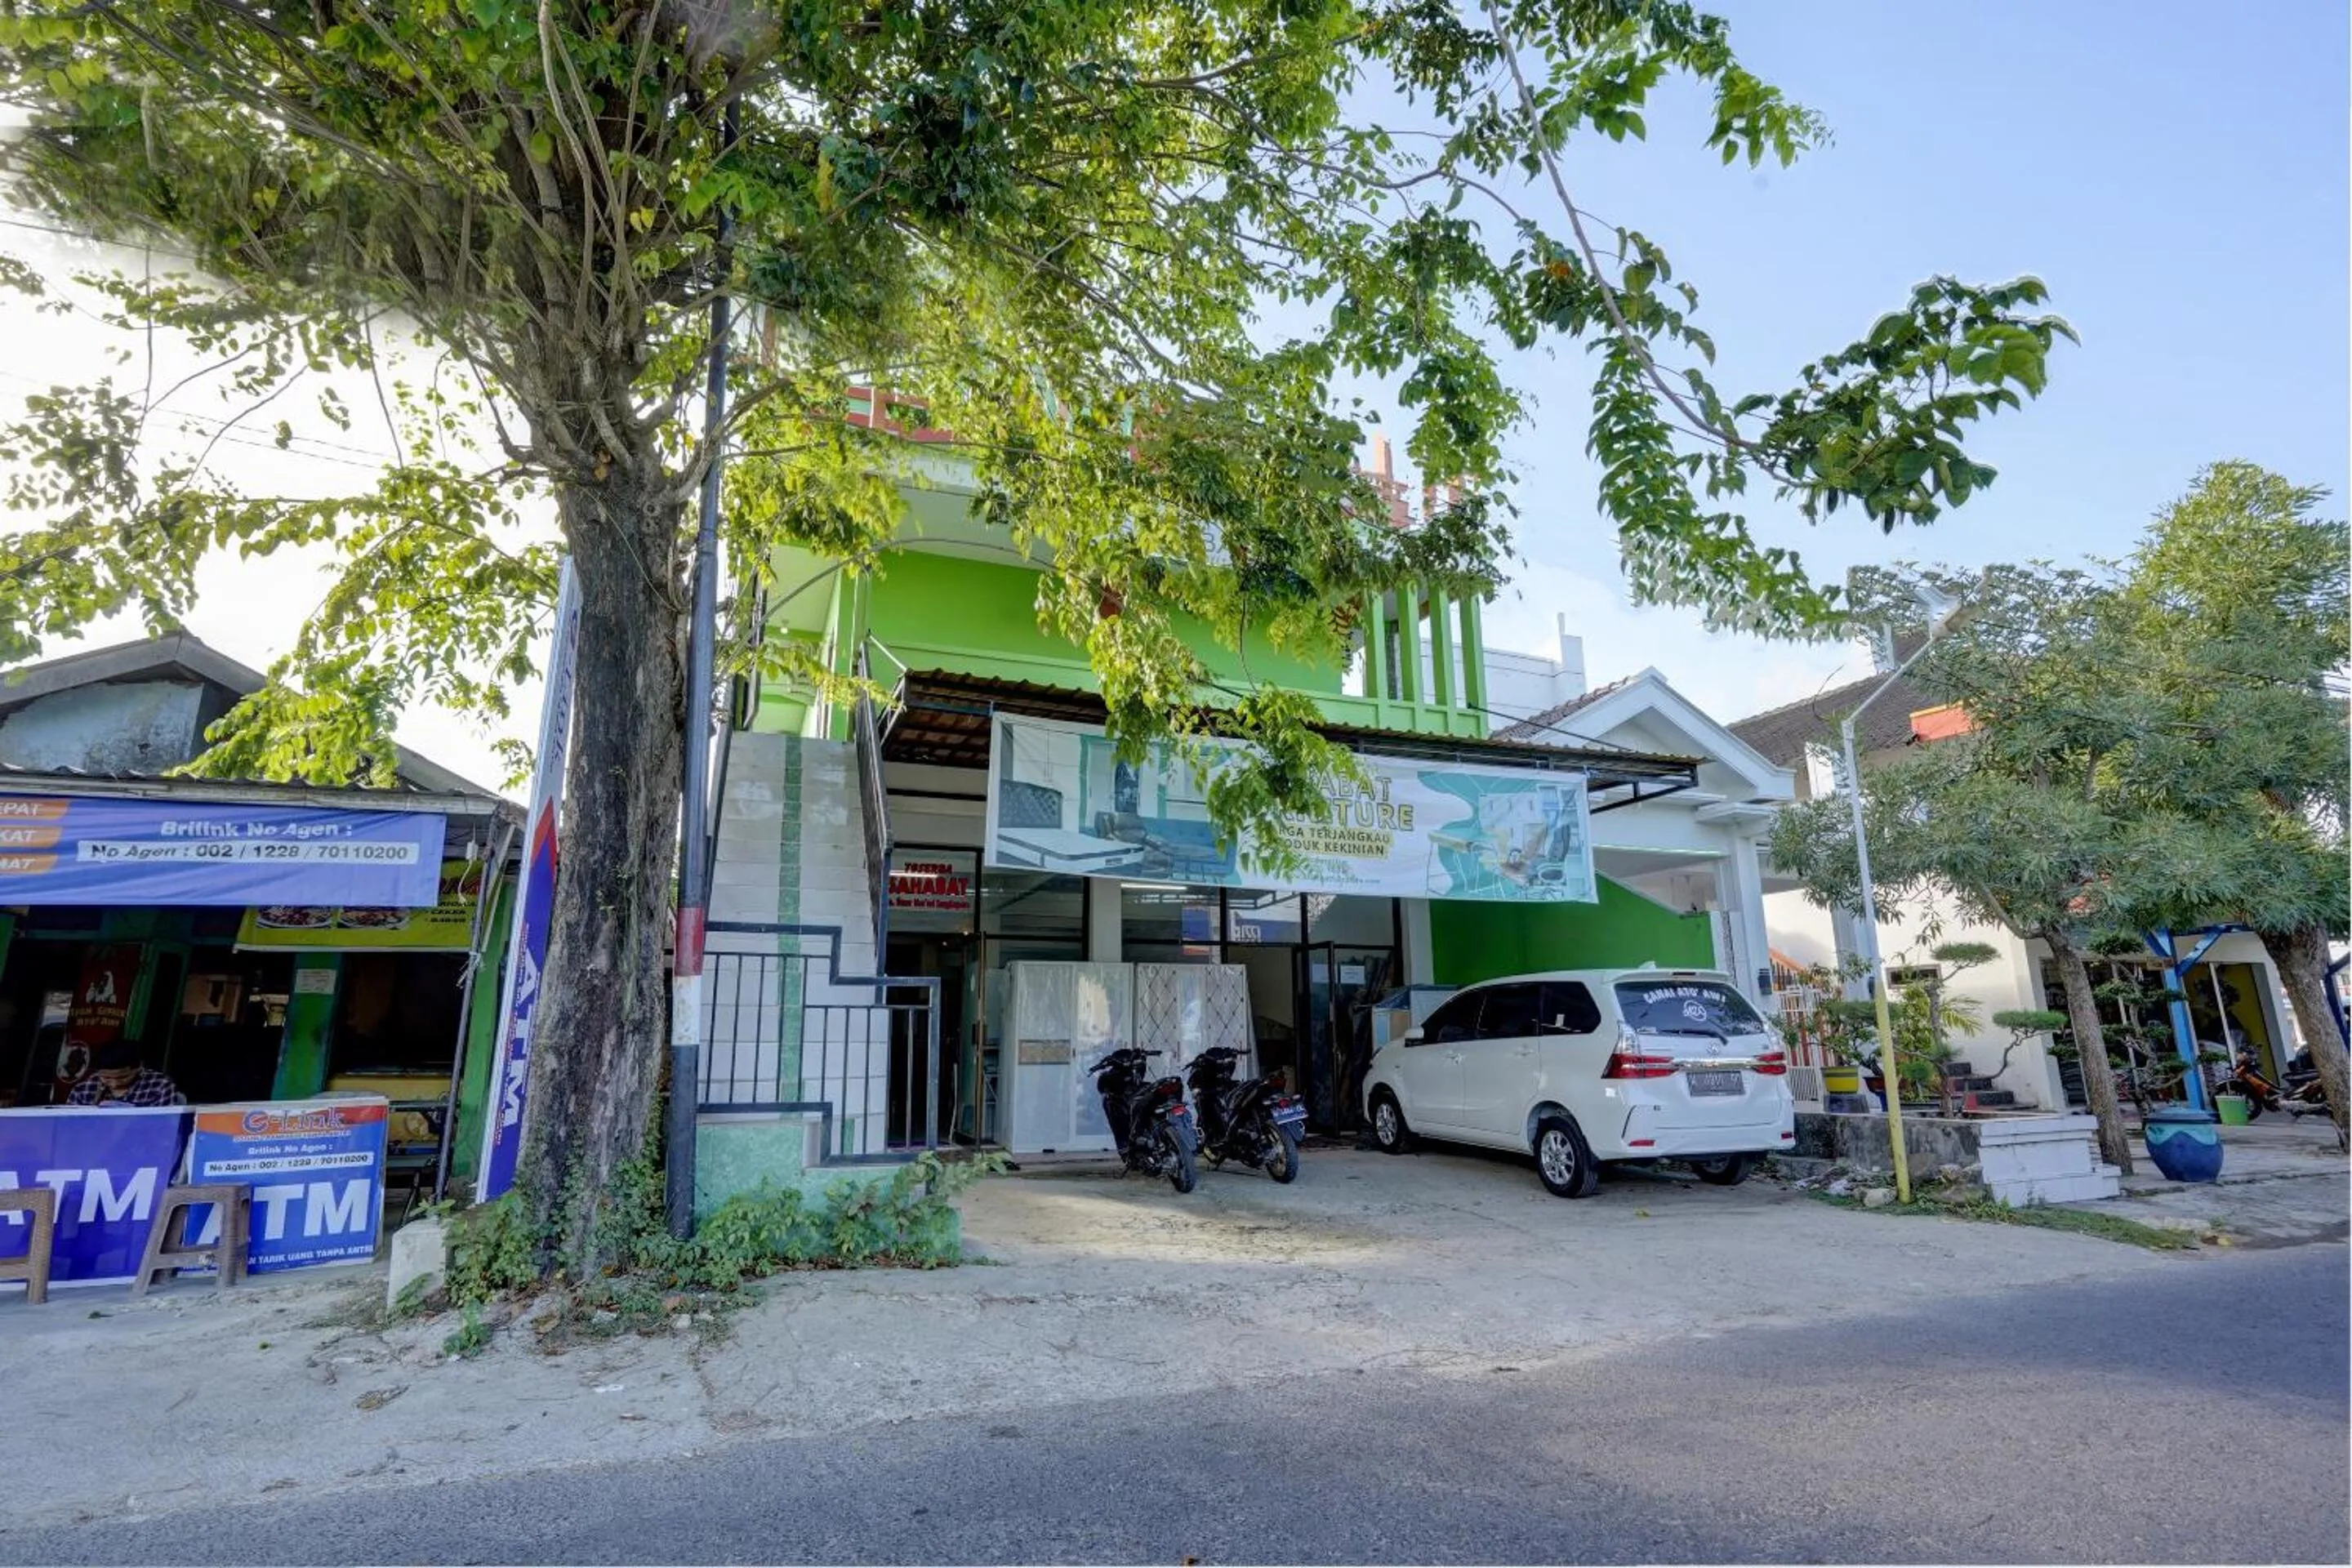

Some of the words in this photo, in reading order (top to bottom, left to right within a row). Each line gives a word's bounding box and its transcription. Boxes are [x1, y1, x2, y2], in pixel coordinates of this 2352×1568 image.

[247, 822, 277, 836] No
[283, 822, 338, 839] Agen
[346, 824, 352, 836] :
[1280, 826, 1304, 836] RGA
[1310, 827, 1389, 844] TERJANGKAU
[91, 844, 119, 858] No
[125, 844, 176, 858] Agen
[184, 846, 188, 857] :
[196, 844, 233, 858] 002
[239, 844, 246, 858] /
[253, 844, 299, 858] 1228
[318, 846, 408, 859] 70110200
[1285, 839, 1321, 851] ODUK
[1324, 843, 1384, 856] KEKINIAN
[889, 876, 968, 895] SAHABAT
[503, 947, 541, 1129] ATM
[301, 1144, 327, 1153] Agen
[225, 1161, 251, 1171] Agen
